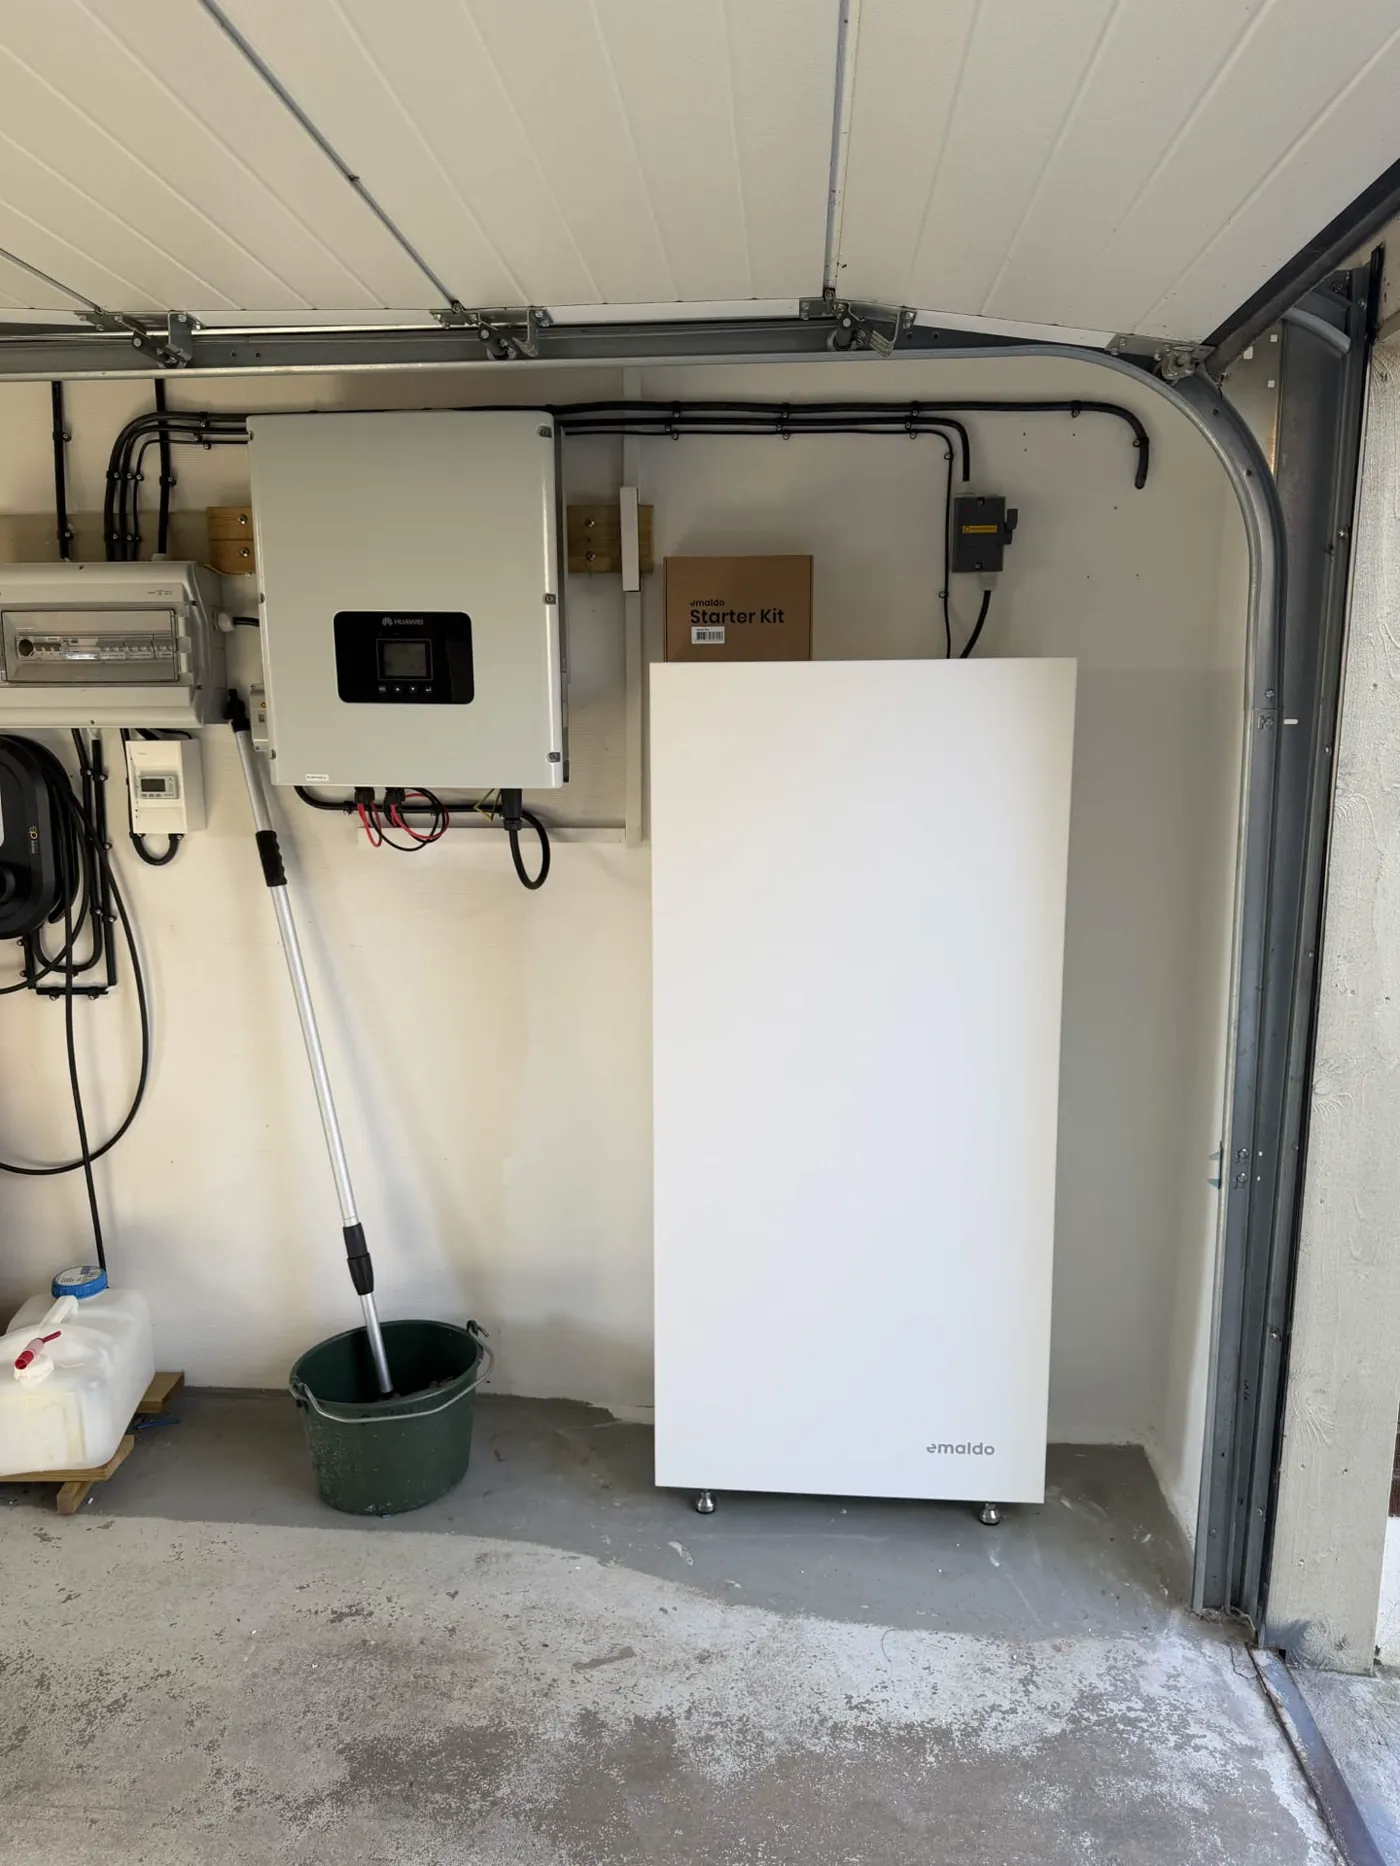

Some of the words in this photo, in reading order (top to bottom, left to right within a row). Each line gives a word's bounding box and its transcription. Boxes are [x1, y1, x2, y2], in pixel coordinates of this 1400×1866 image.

[690, 599, 725, 607] emaldo
[690, 609, 756, 624] Starter
[760, 608, 785, 624] Kit
[926, 1442, 995, 1456] emaldo
